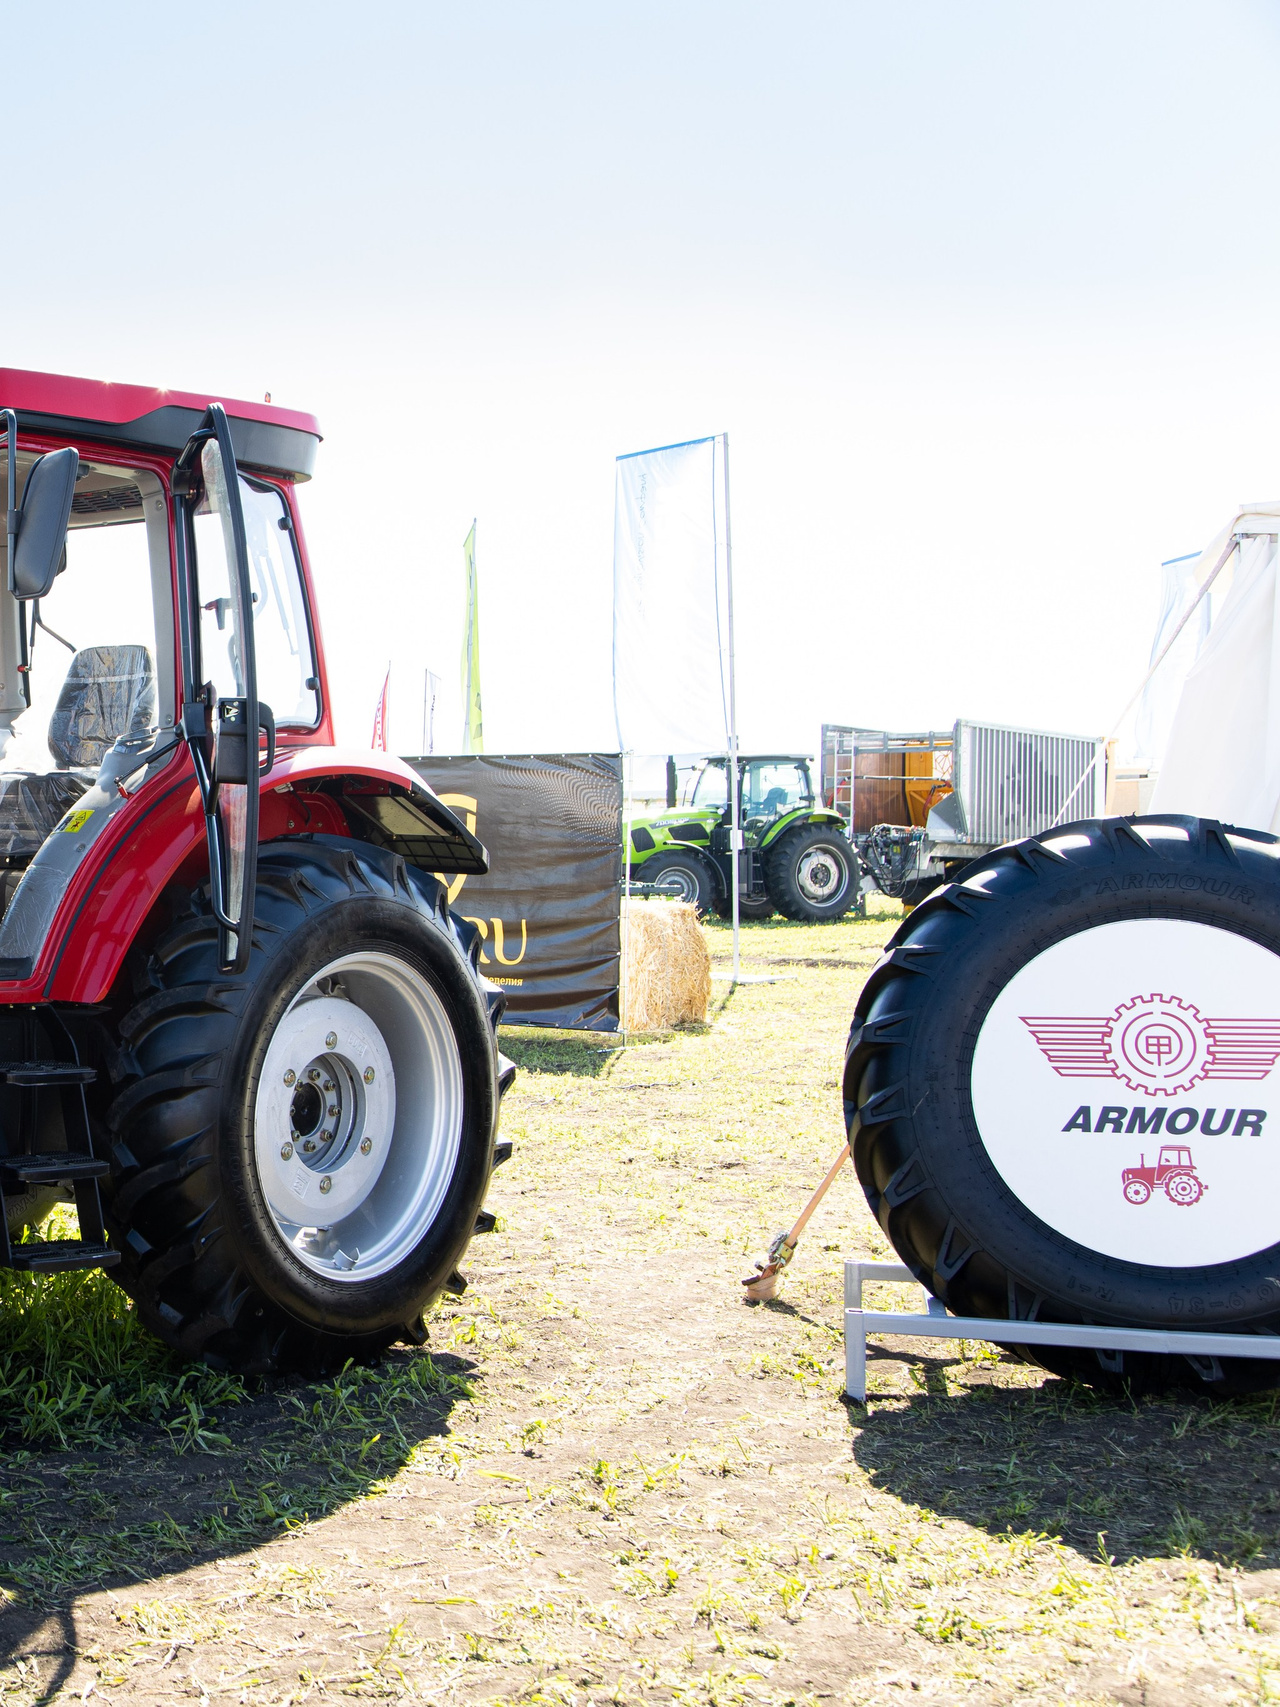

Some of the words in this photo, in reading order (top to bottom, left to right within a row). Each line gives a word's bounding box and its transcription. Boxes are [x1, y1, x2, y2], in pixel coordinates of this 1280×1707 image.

[1096, 872, 1257, 905] ARMOUR
[485, 976, 523, 987] еделия
[1061, 1105, 1268, 1138] ARMOUR
